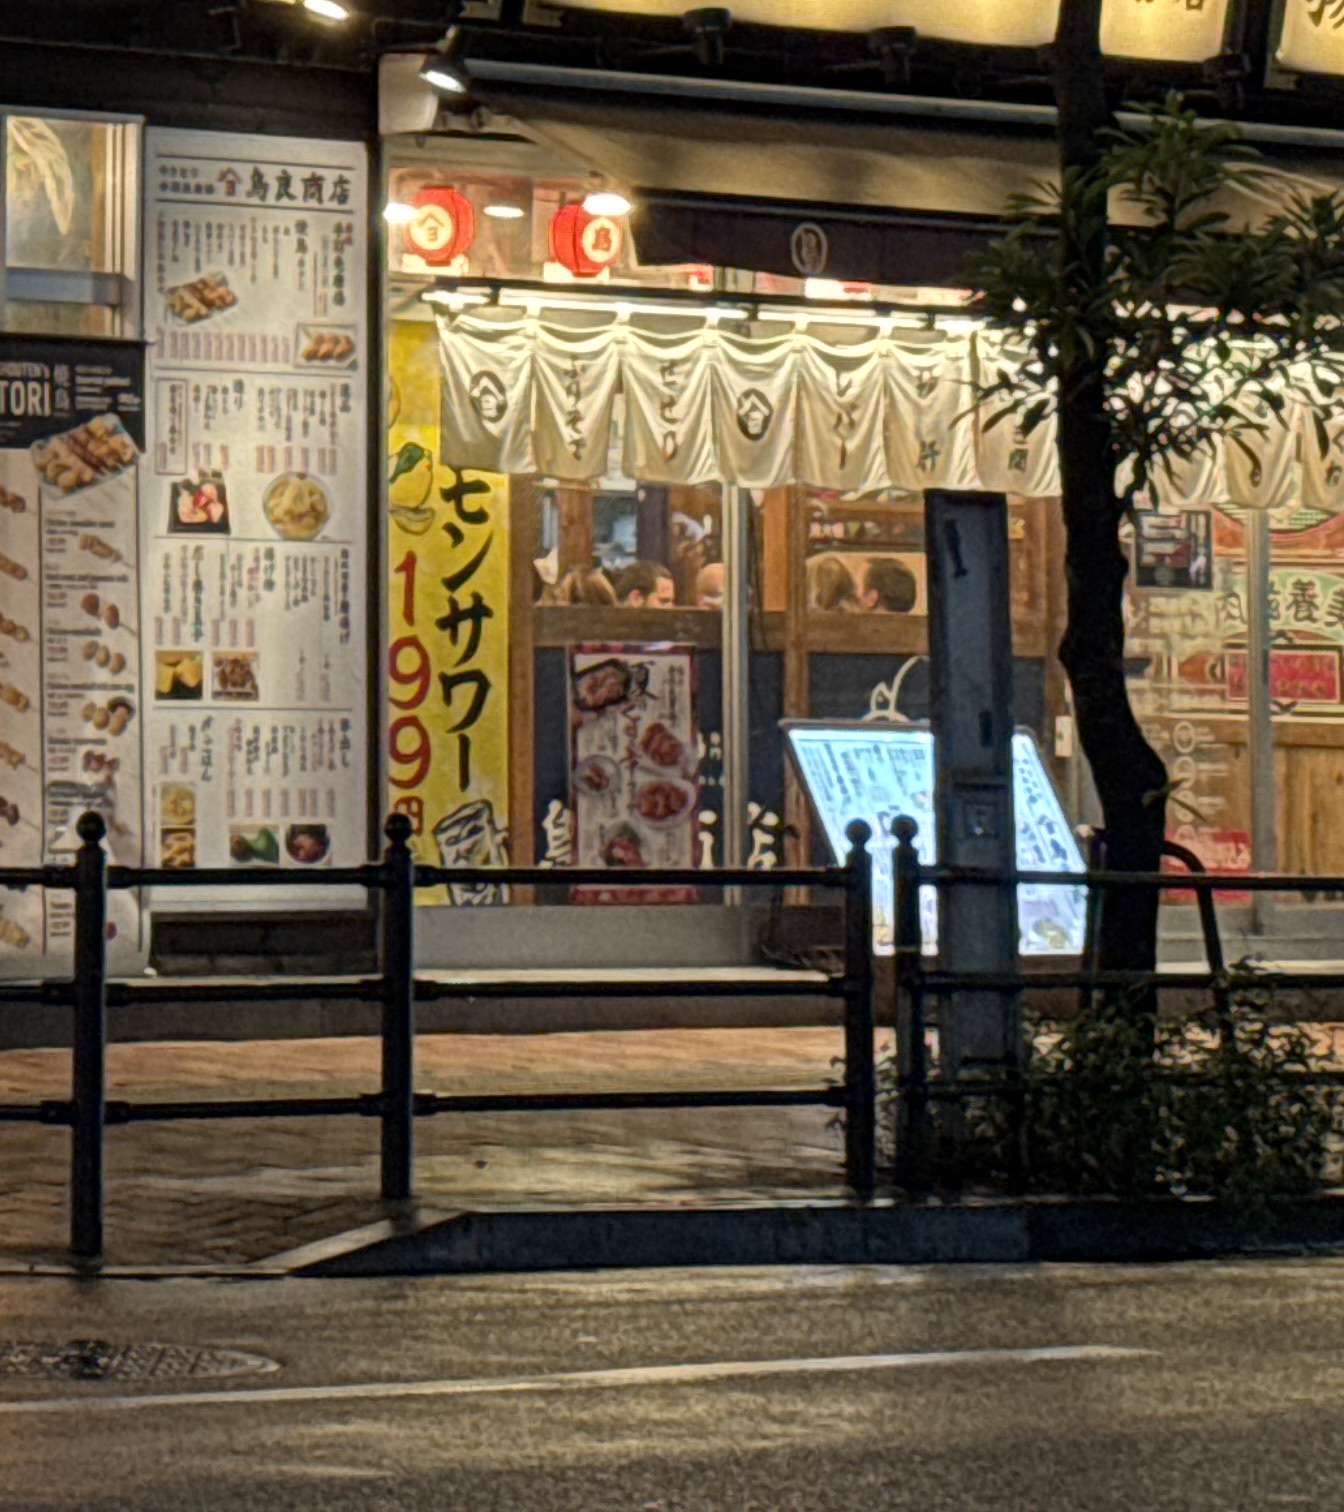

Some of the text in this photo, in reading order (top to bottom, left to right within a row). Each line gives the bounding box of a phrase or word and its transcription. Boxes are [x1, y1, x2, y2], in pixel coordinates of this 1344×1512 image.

[245, 165, 352, 206] 鳥良商店
[435, 466, 496, 793] モンサワー
